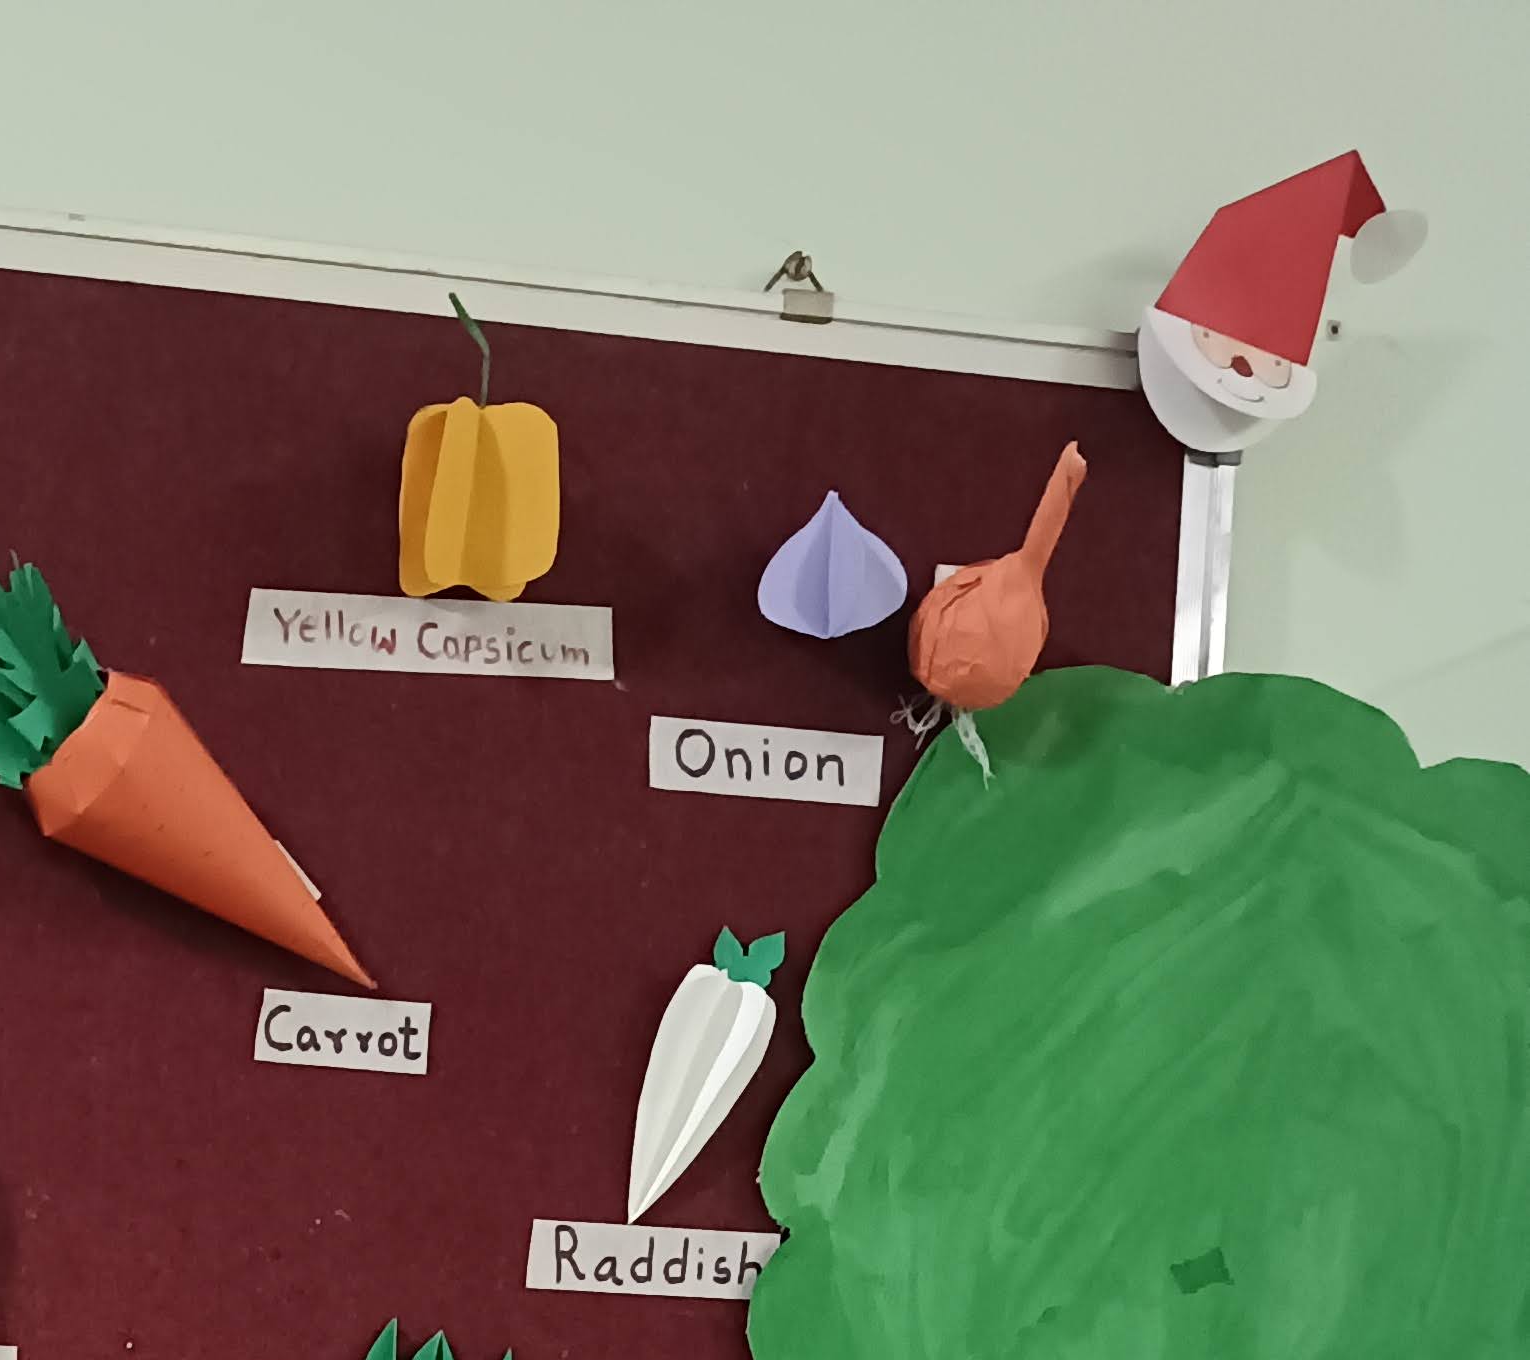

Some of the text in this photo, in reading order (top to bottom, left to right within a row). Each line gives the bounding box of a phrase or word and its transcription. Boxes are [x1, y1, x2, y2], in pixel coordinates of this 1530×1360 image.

[272, 606, 592, 667] Yellow Capsicum
[674, 728, 846, 787] Onion
[263, 1004, 423, 1061] Carrot
[553, 1223, 762, 1286] Raddish
